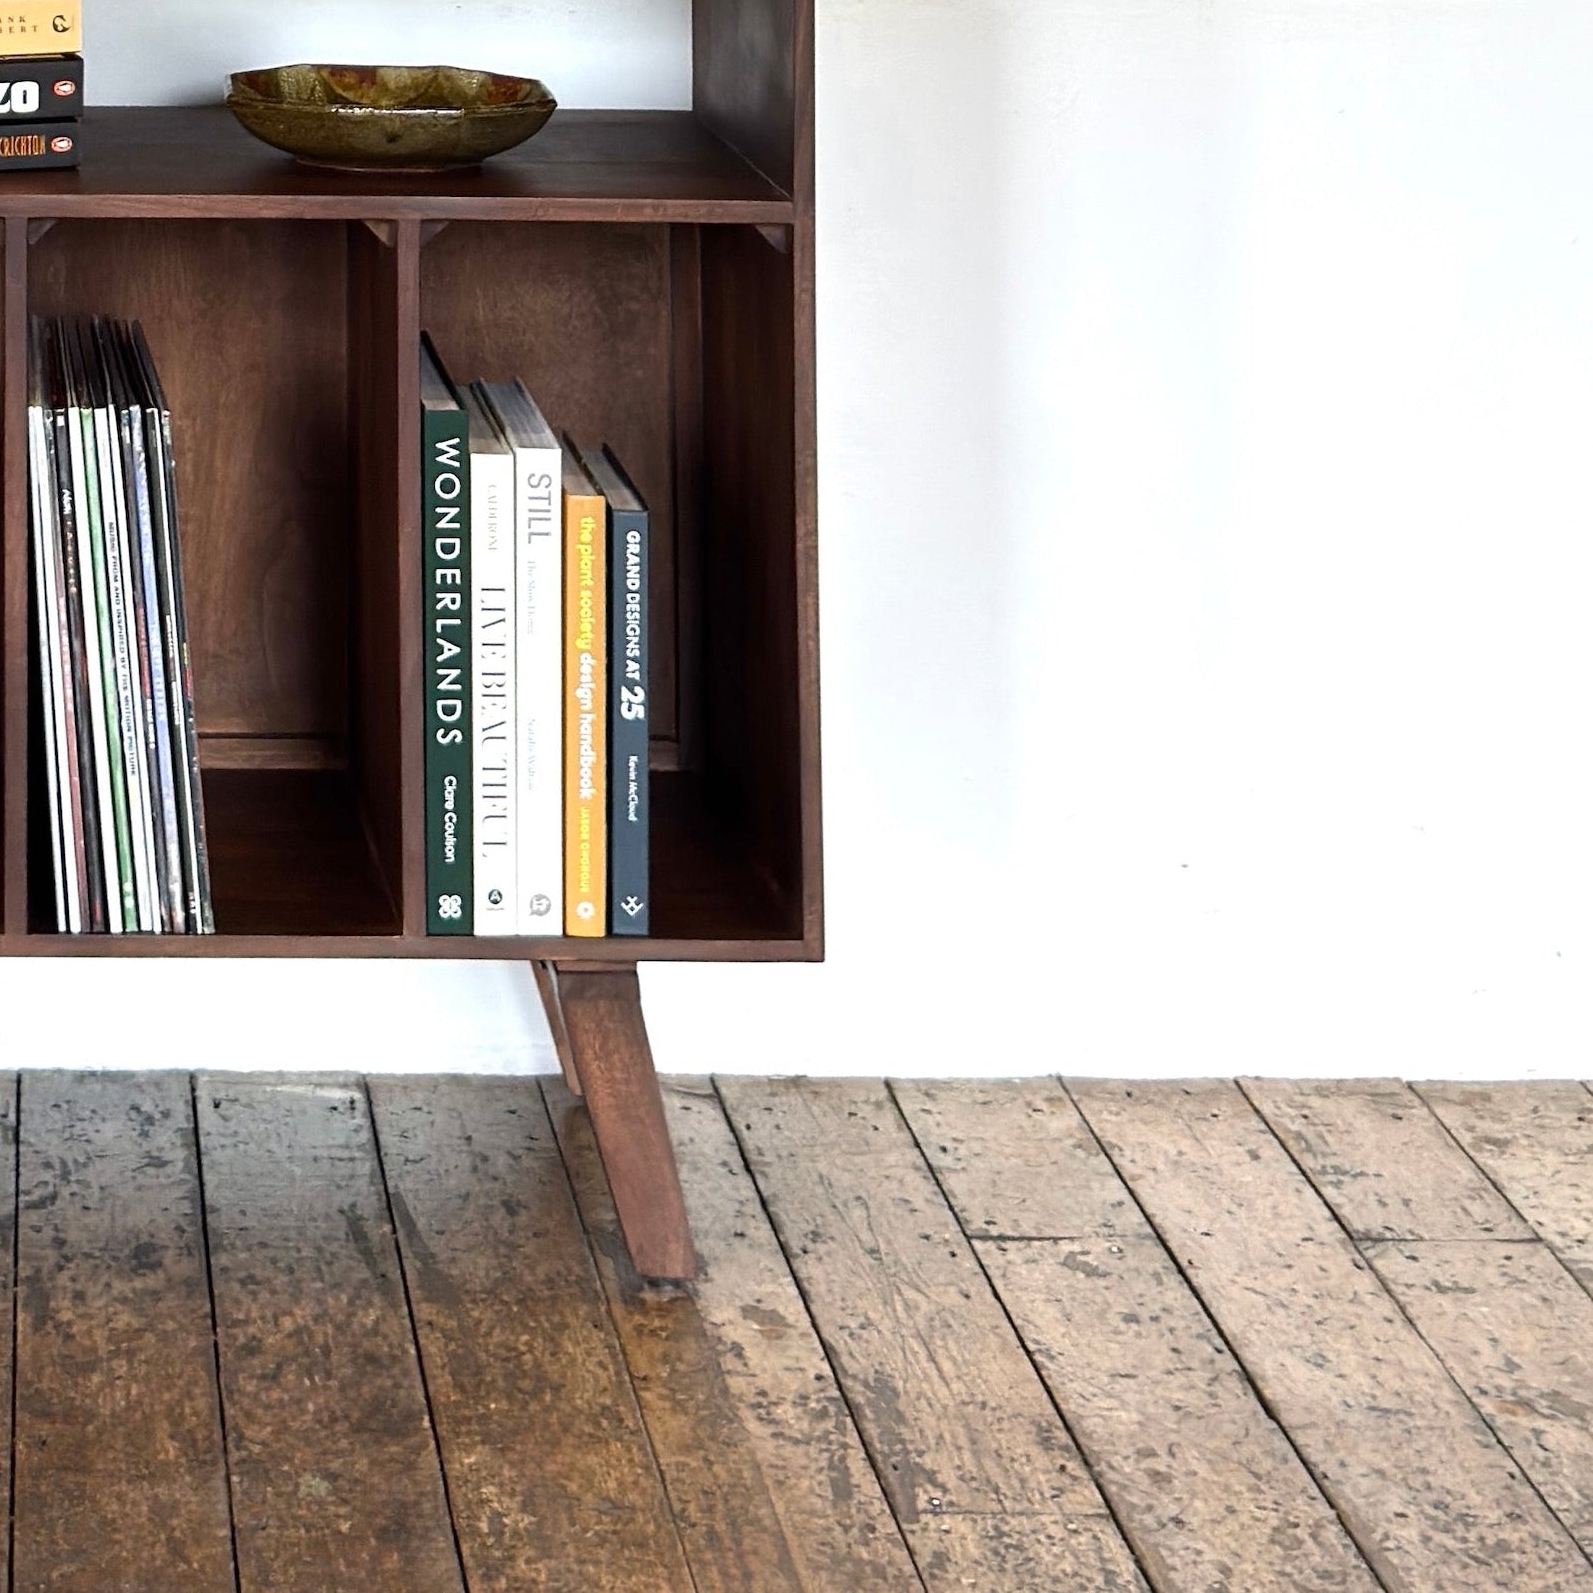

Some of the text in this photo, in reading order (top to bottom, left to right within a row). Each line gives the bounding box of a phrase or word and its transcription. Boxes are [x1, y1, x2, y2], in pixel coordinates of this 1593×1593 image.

[527, 472, 552, 544] STILL
[580, 516, 596, 542] the
[574, 544, 596, 586] plant
[434, 437, 463, 863] WONDERLANDS Clare Coulson
[480, 587, 506, 659] LIVE
[574, 590, 596, 650] society
[620, 530, 646, 721] GRAND DESIGNS AT 25
[124, 695, 132, 732] MOTION
[574, 652, 597, 710] design
[480, 672, 508, 858] BEAUTIFUL
[579, 713, 597, 800] handbook
[627, 756, 638, 821] Kevin McCloud
